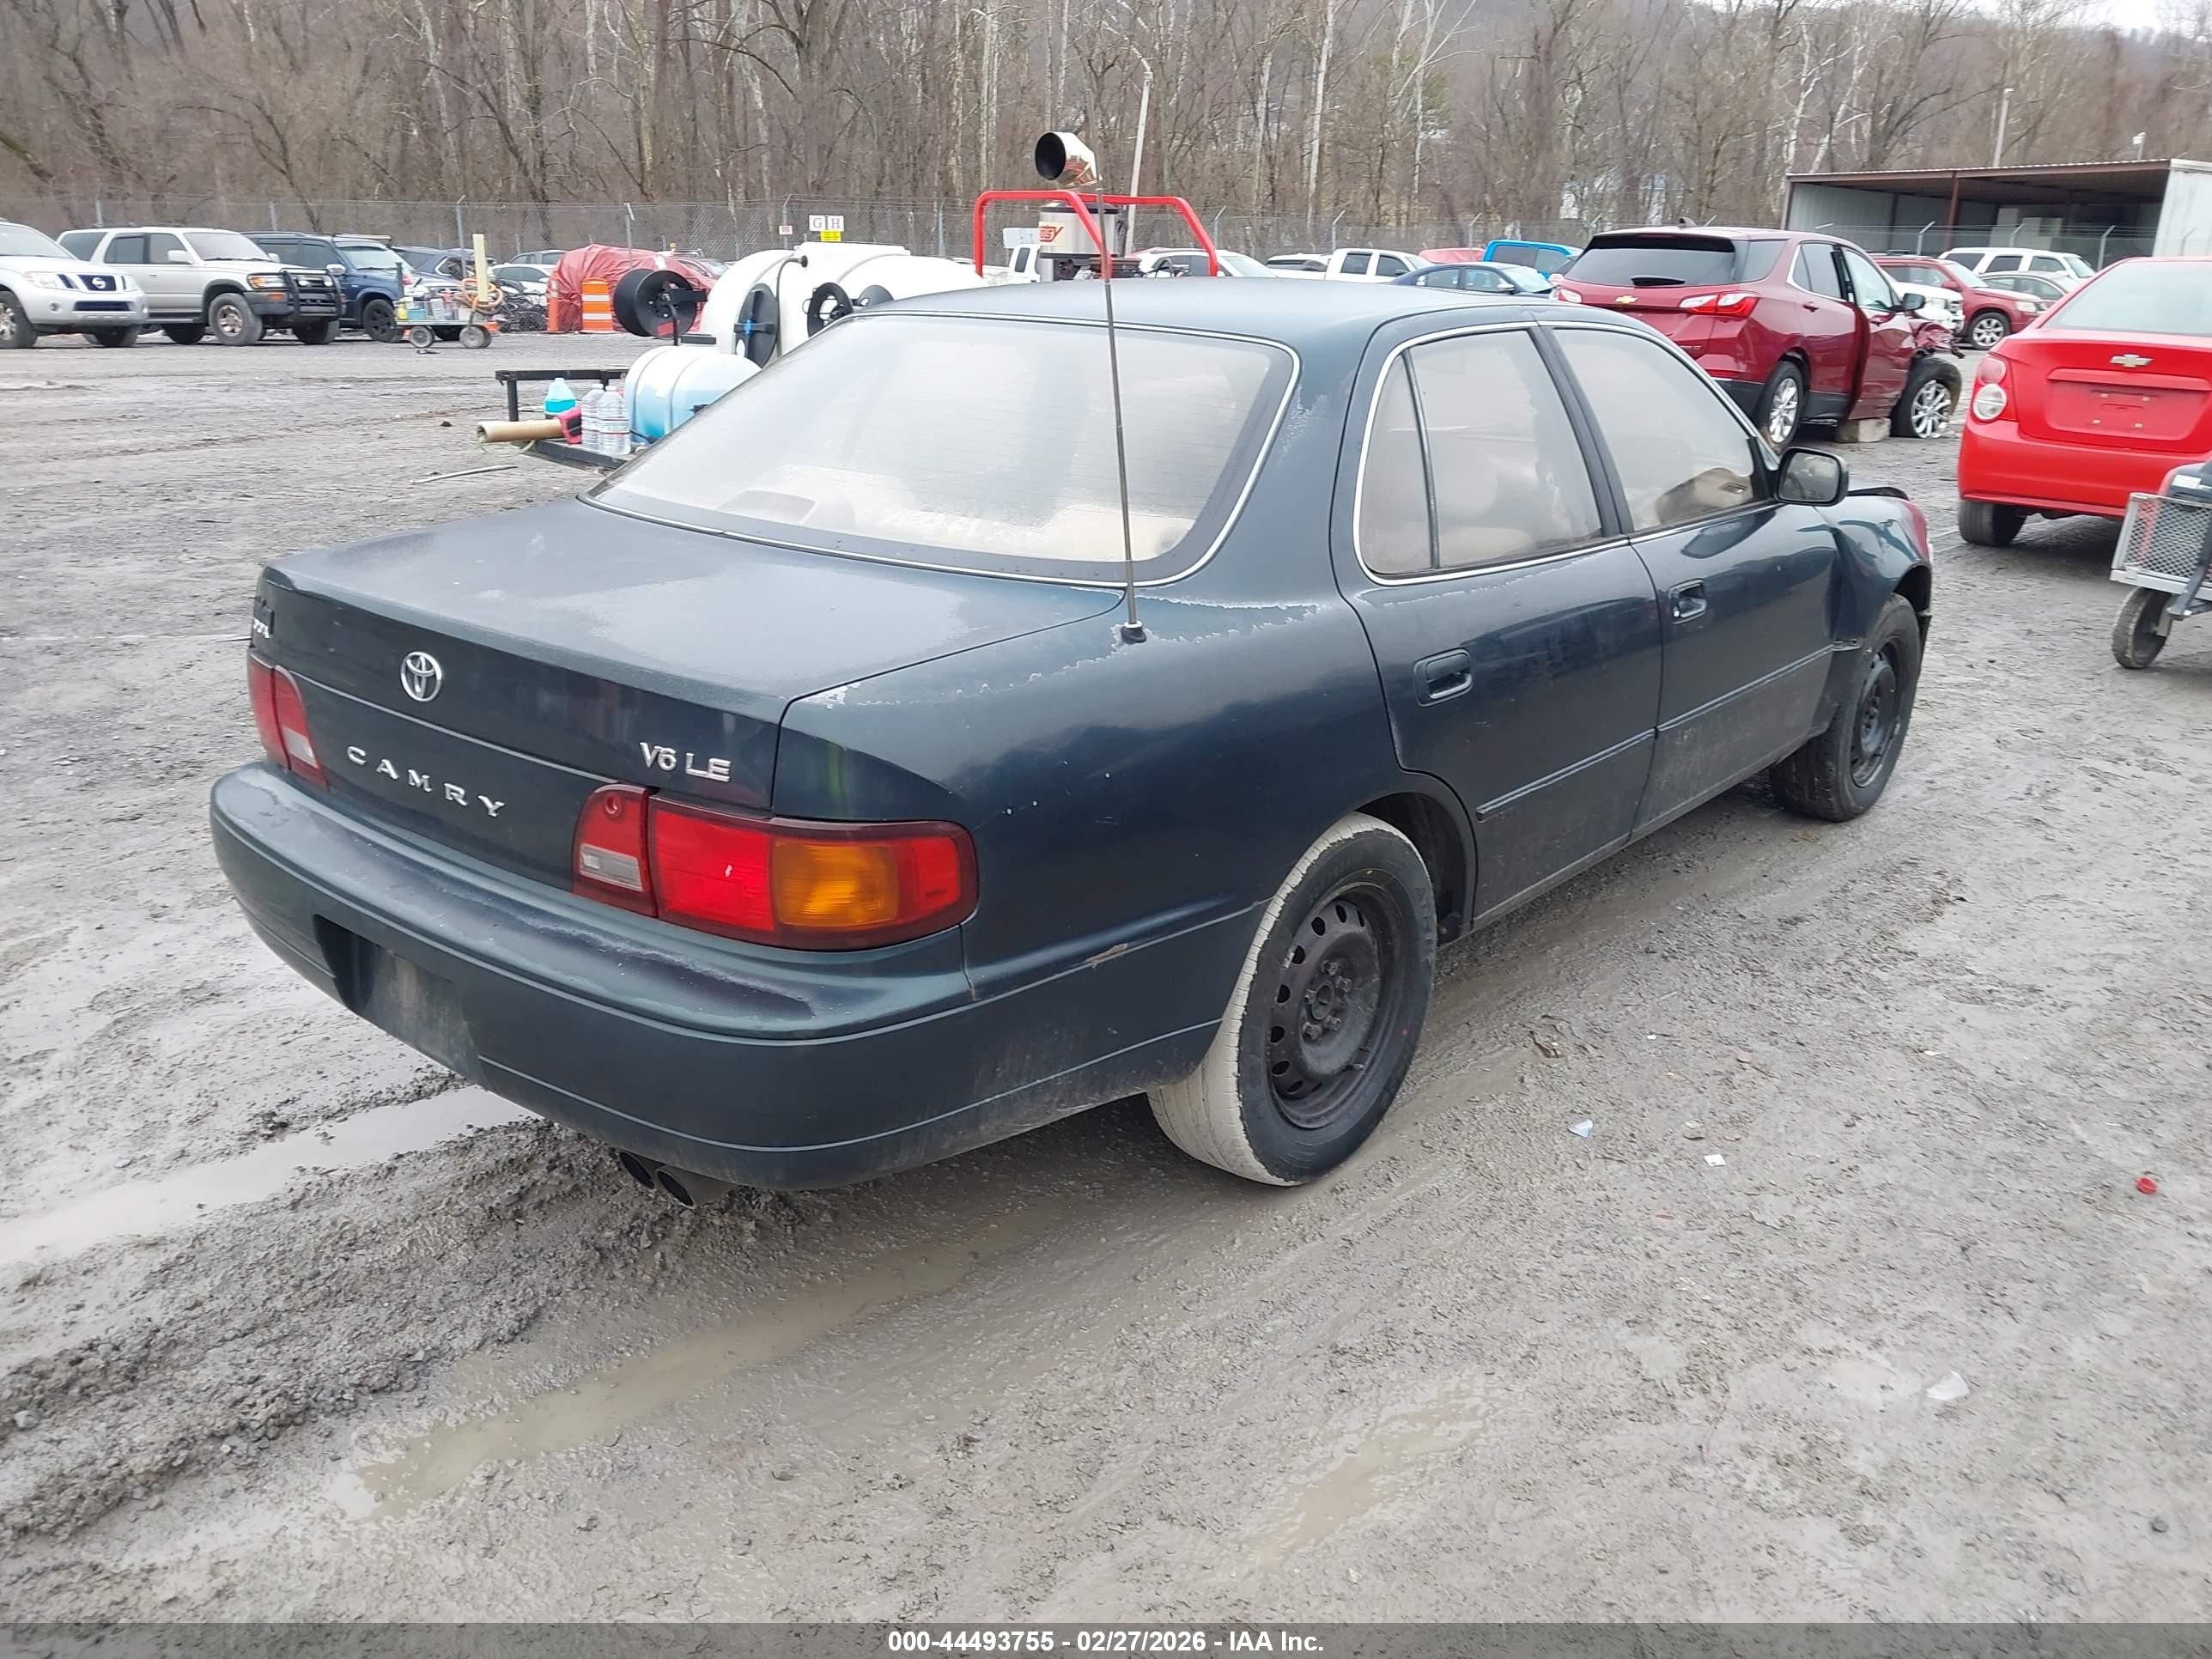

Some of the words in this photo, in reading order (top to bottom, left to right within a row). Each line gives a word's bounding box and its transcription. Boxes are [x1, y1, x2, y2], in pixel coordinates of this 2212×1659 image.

[812, 217, 823, 228] G
[830, 217, 841, 229] H
[639, 741, 678, 771] V6
[685, 752, 732, 783] LE
[346, 745, 506, 817] CAMRY
